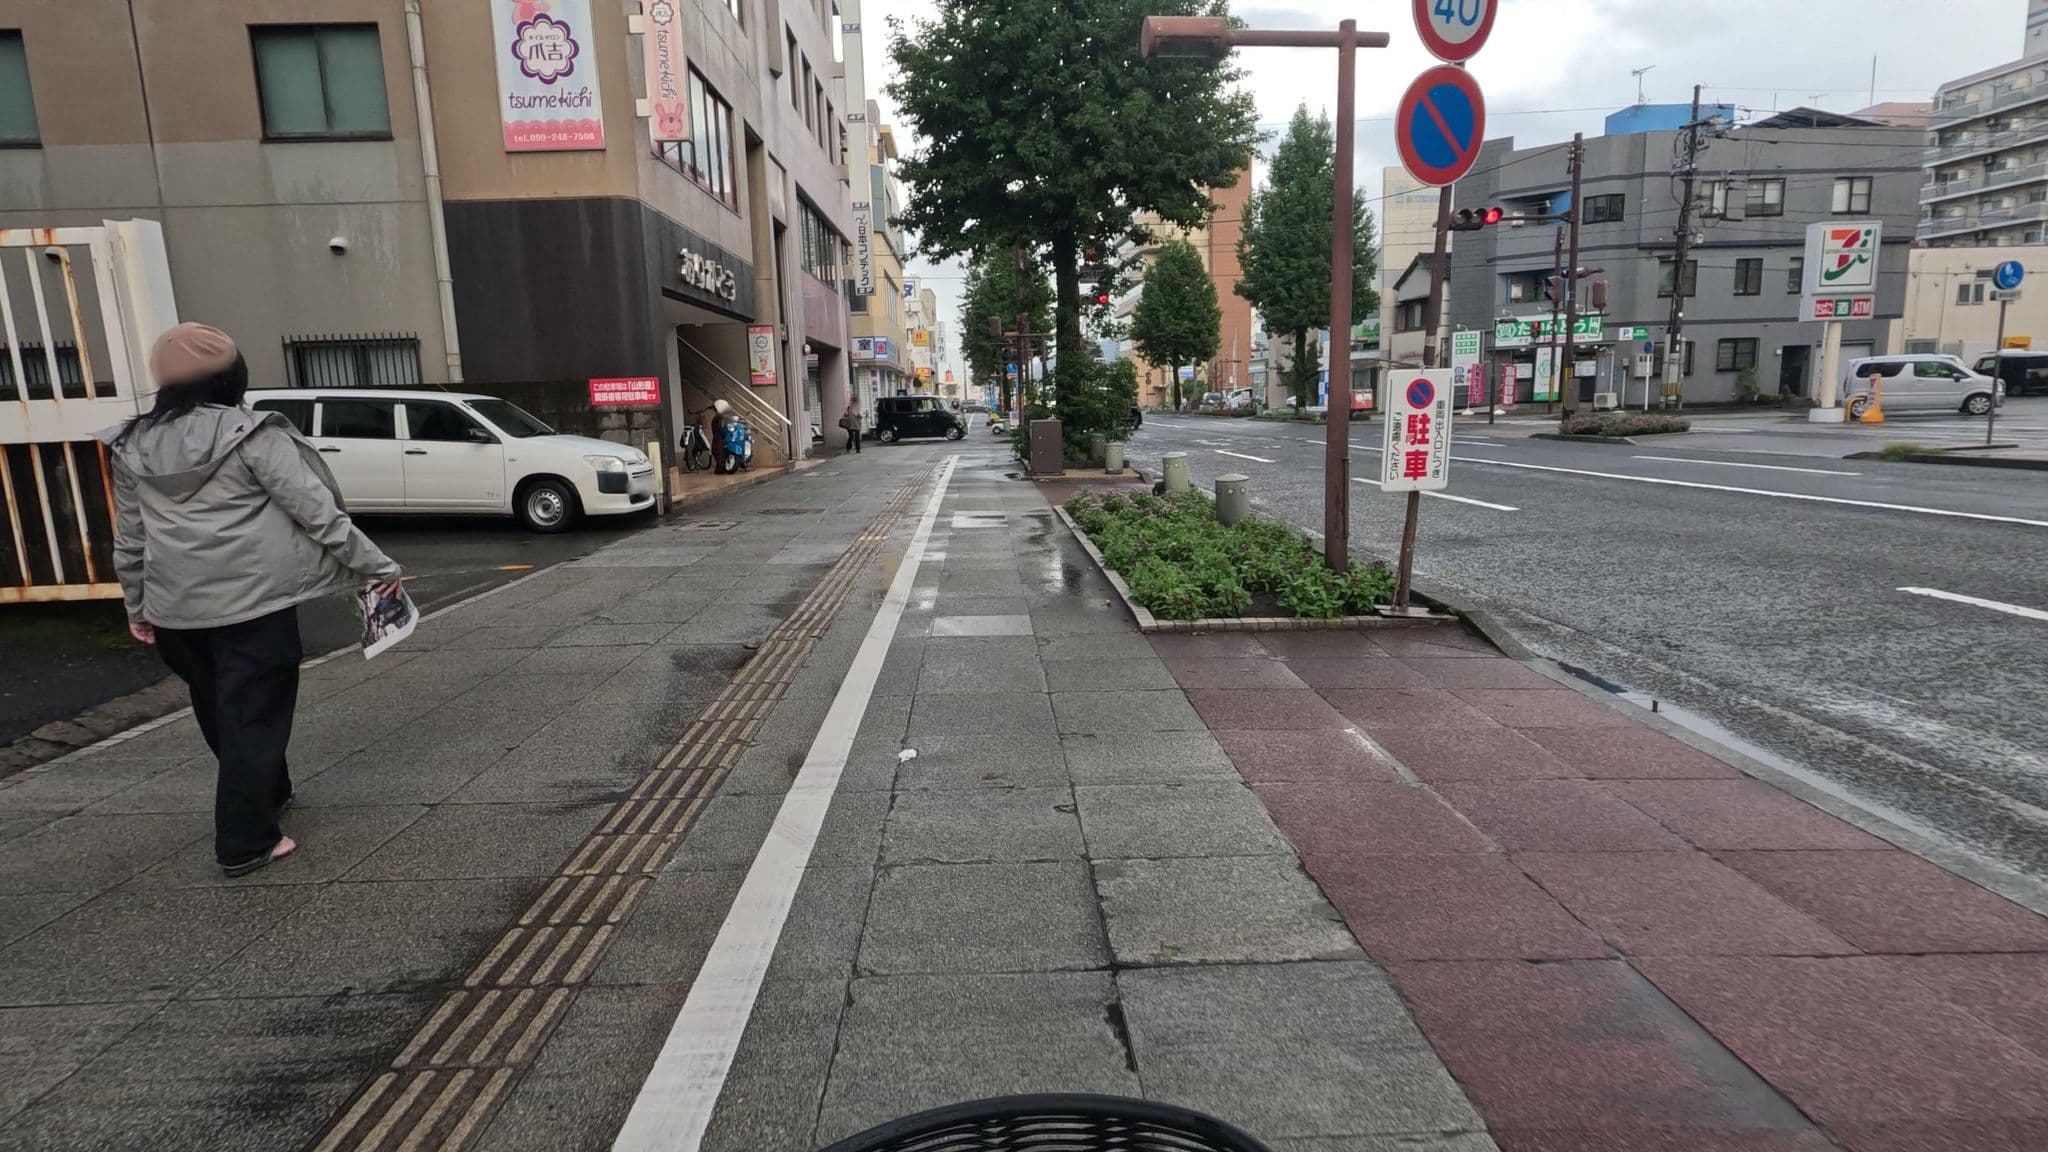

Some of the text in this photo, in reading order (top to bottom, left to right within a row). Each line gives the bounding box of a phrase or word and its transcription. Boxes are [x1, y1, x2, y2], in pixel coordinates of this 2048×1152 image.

[1433, 0, 1480, 26] 40
[528, 42, 564, 61] 爪吉
[1854, 301, 1871, 315] ATM
[1390, 411, 1402, 480] ご遠慮ください
[1403, 412, 1431, 481] 駐車
